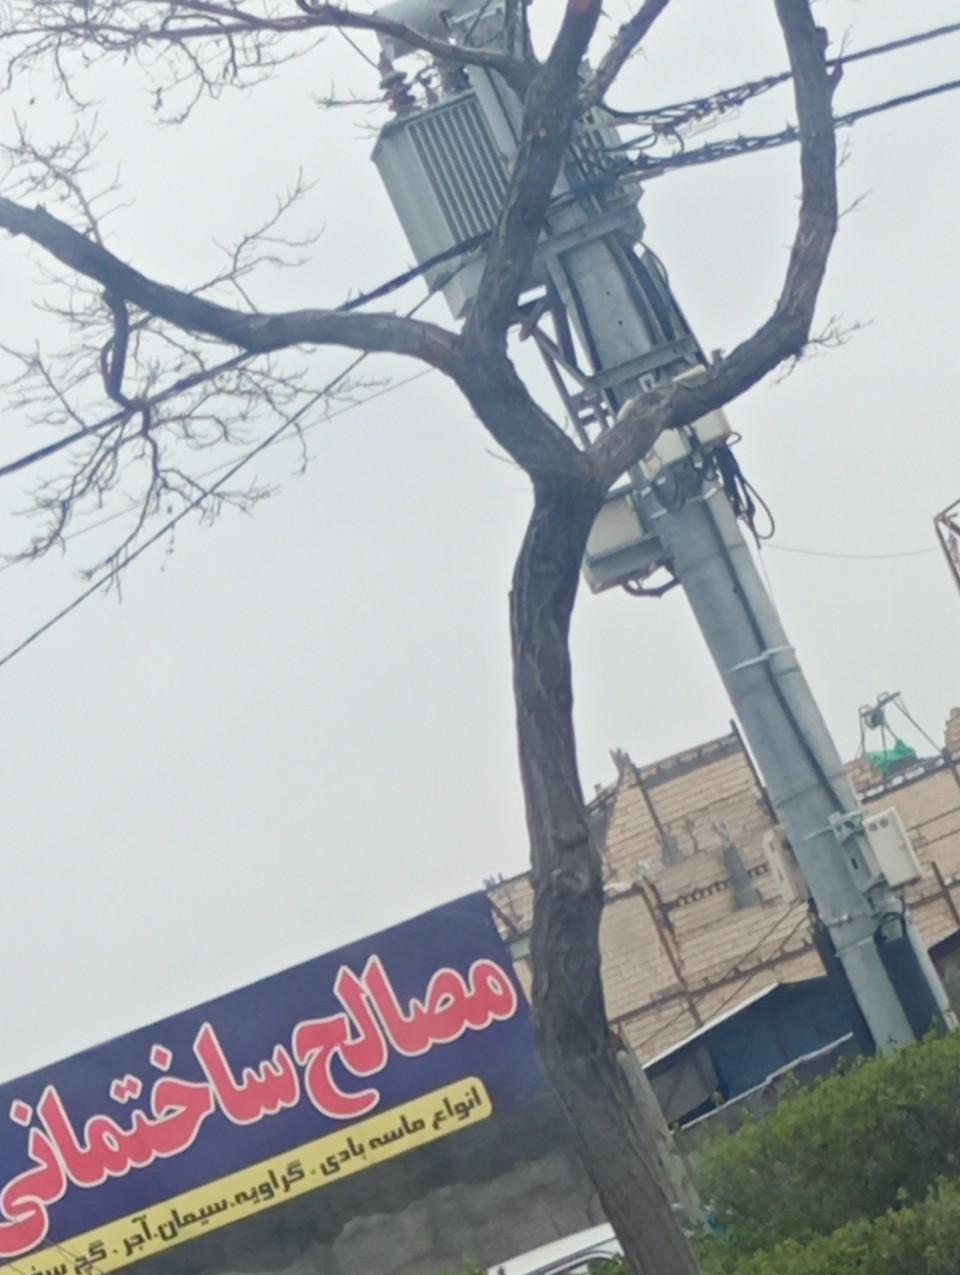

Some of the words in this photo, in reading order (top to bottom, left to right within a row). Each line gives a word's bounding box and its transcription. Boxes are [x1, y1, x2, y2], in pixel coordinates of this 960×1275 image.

[292, 954, 517, 1119] مصالح
[432, 1086, 482, 1130] انواع
[369, 1114, 426, 1150] ماسه
[320, 1137, 367, 1176] بادی
[123, 1214, 153, 1256] آجر
[157, 1199, 228, 1241] سیمان
